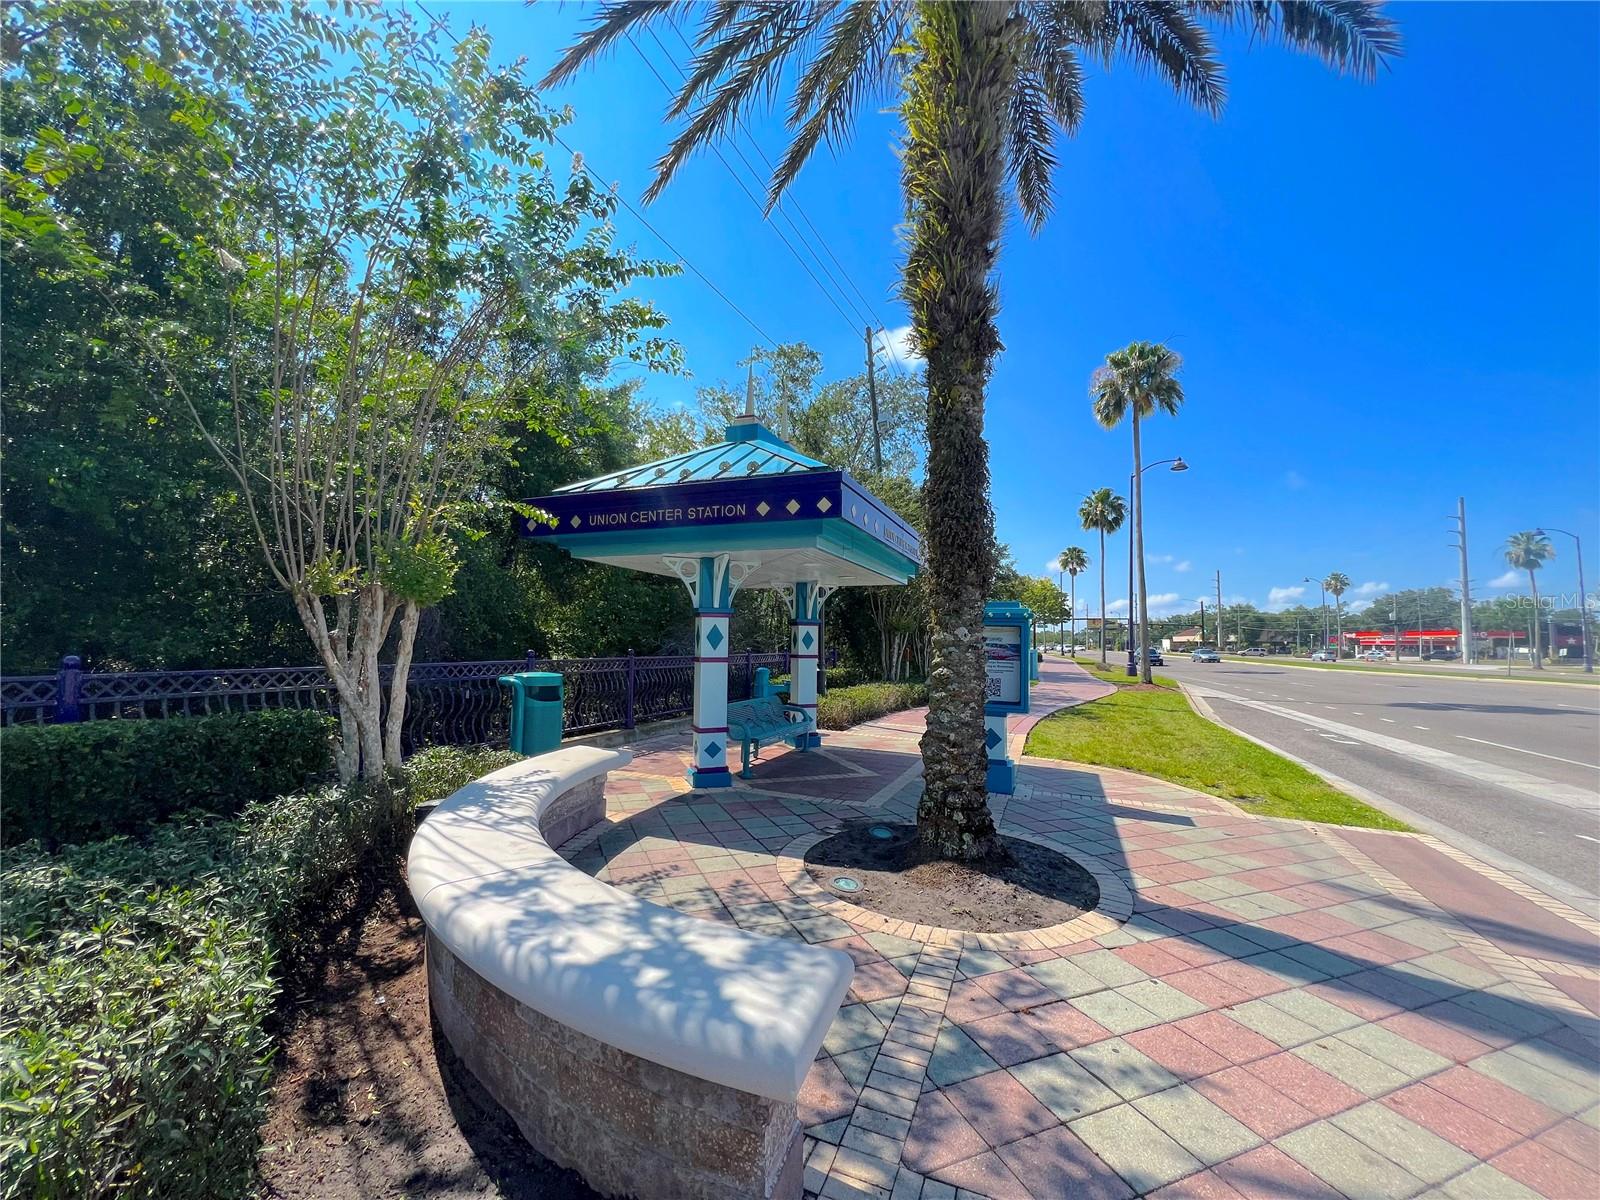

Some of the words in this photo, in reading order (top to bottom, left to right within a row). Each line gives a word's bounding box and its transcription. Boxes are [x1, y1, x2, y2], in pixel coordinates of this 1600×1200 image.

[589, 512, 627, 526] UNION
[630, 508, 683, 523] CENTER
[687, 503, 746, 520] STATION
